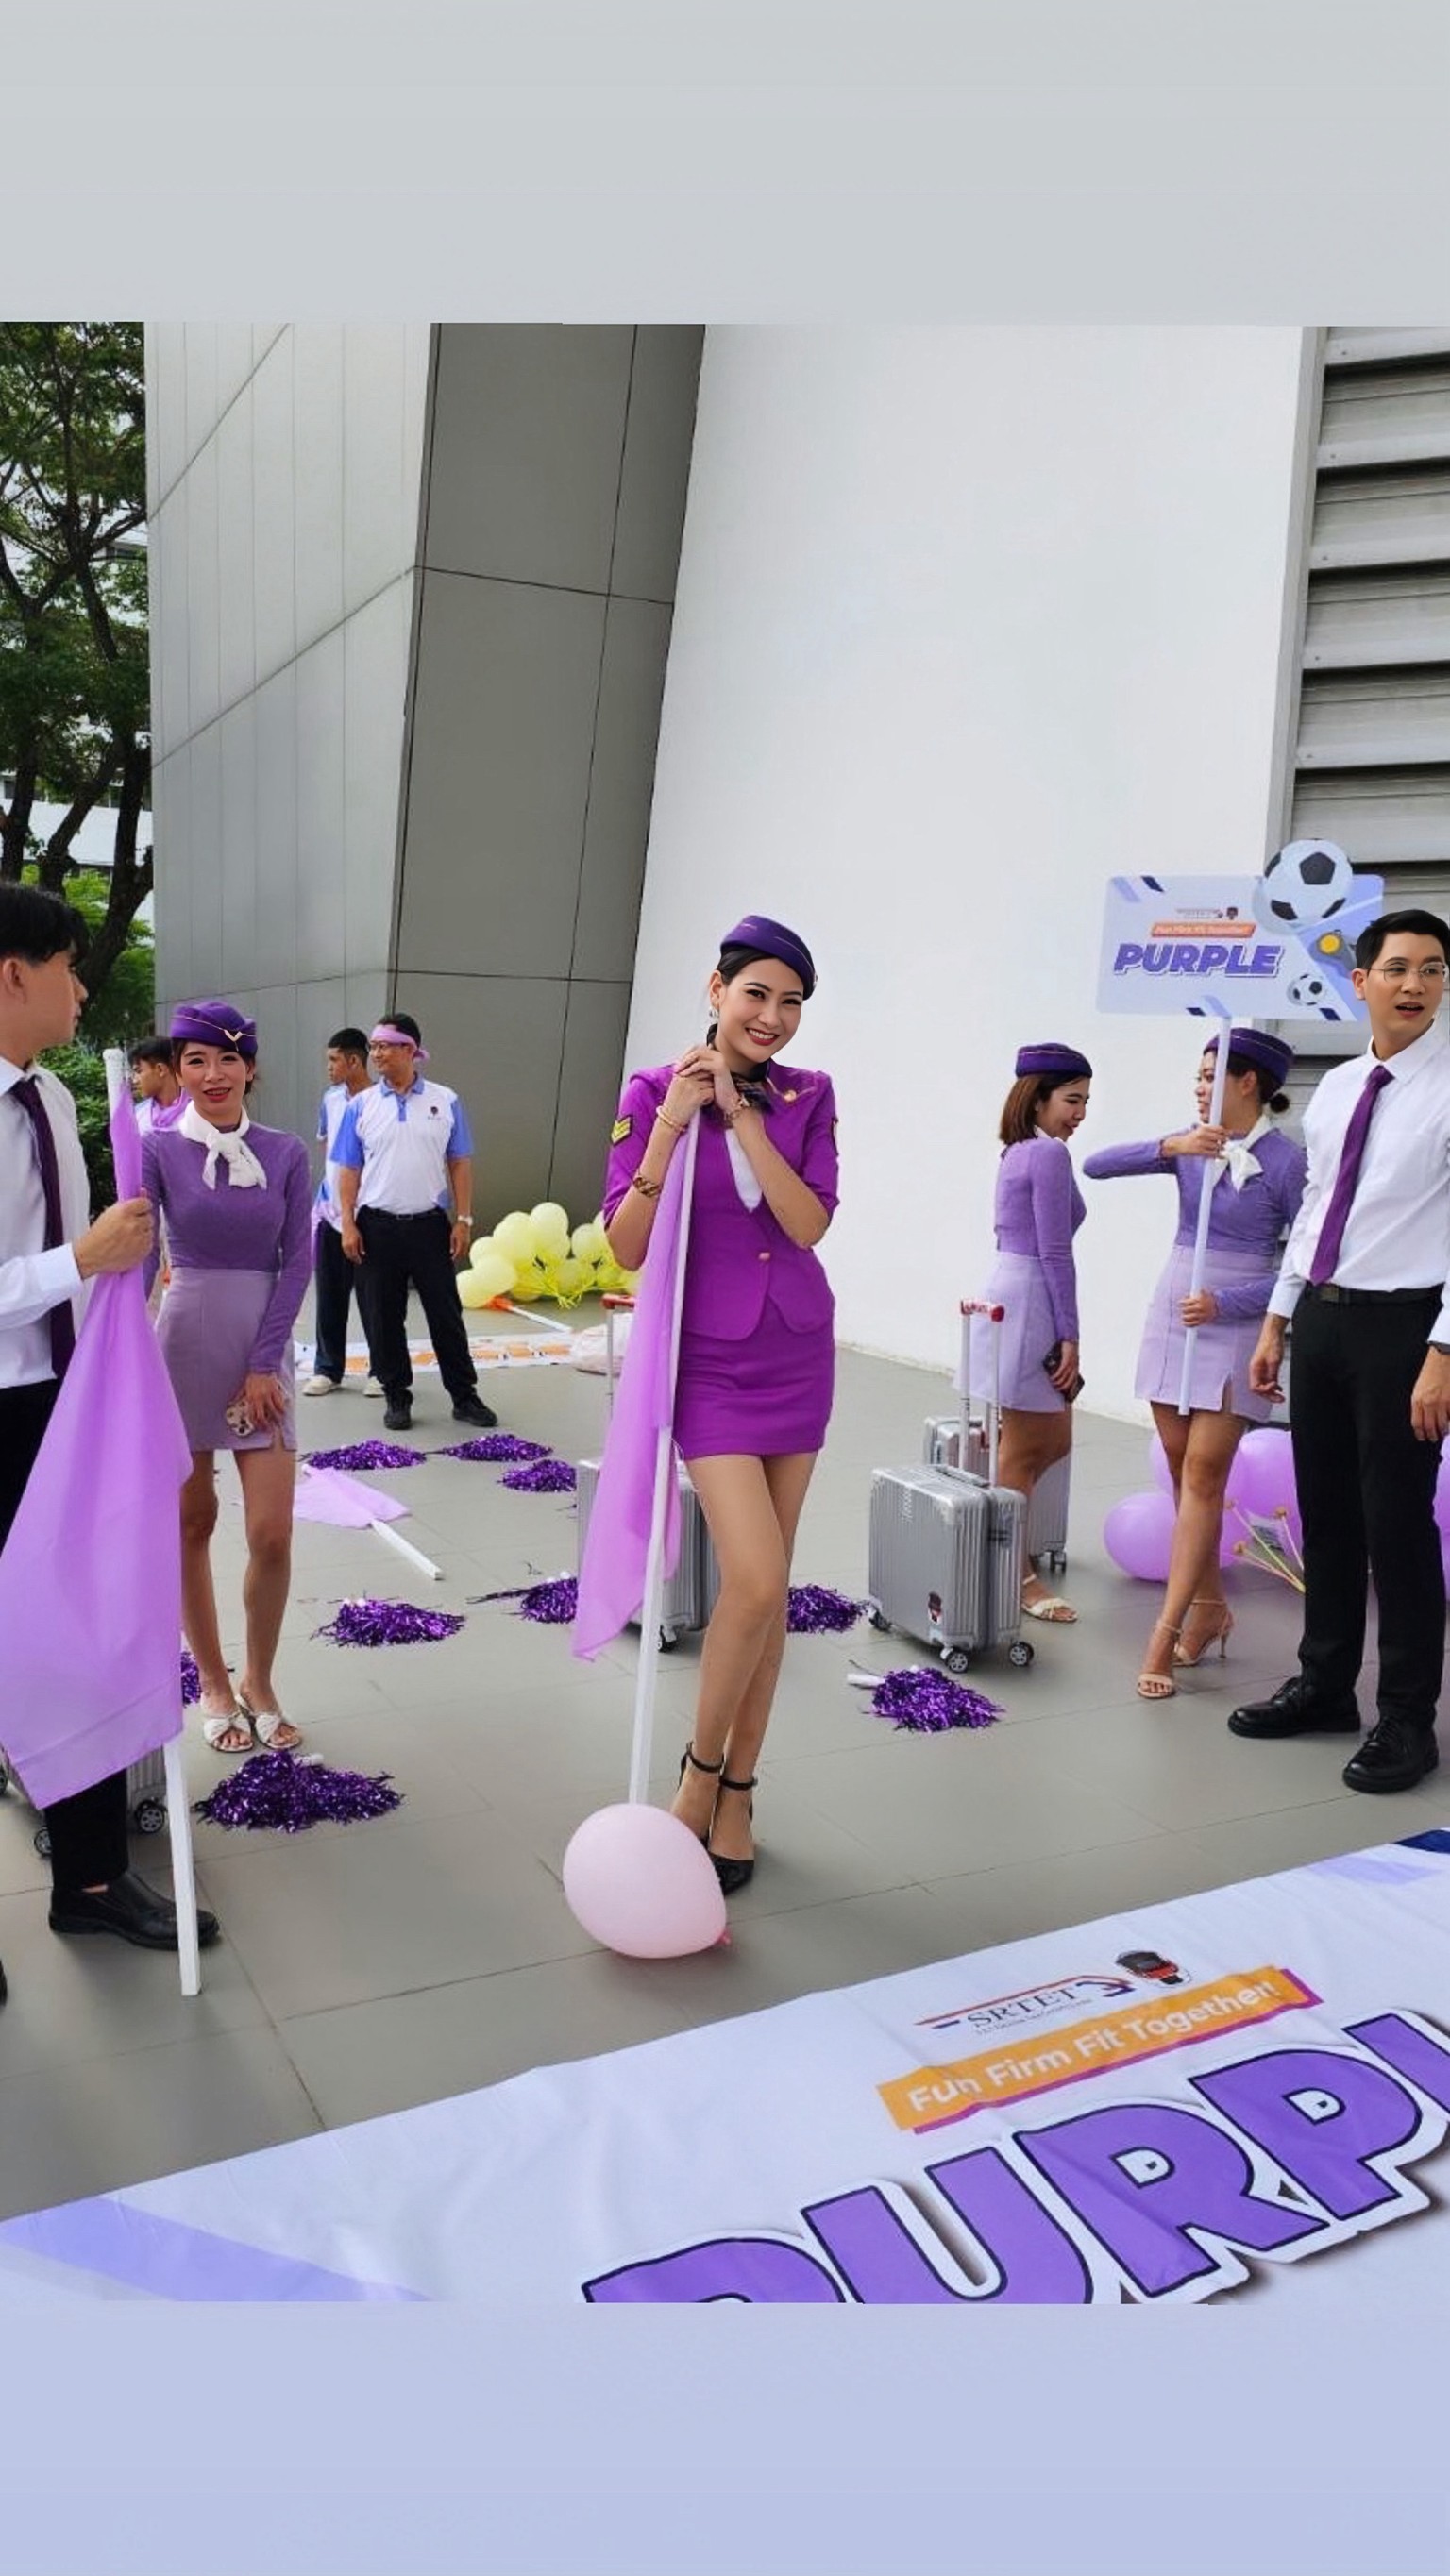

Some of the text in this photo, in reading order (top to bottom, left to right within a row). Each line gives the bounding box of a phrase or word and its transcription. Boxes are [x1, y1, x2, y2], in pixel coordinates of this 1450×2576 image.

[1114, 943, 1284, 977] PURPLE
[968, 1987, 1075, 2027] SRTET
[908, 2078, 982, 2112] Fun
[986, 2050, 1072, 2087] Firm
[1073, 2028, 1125, 2058] Fit
